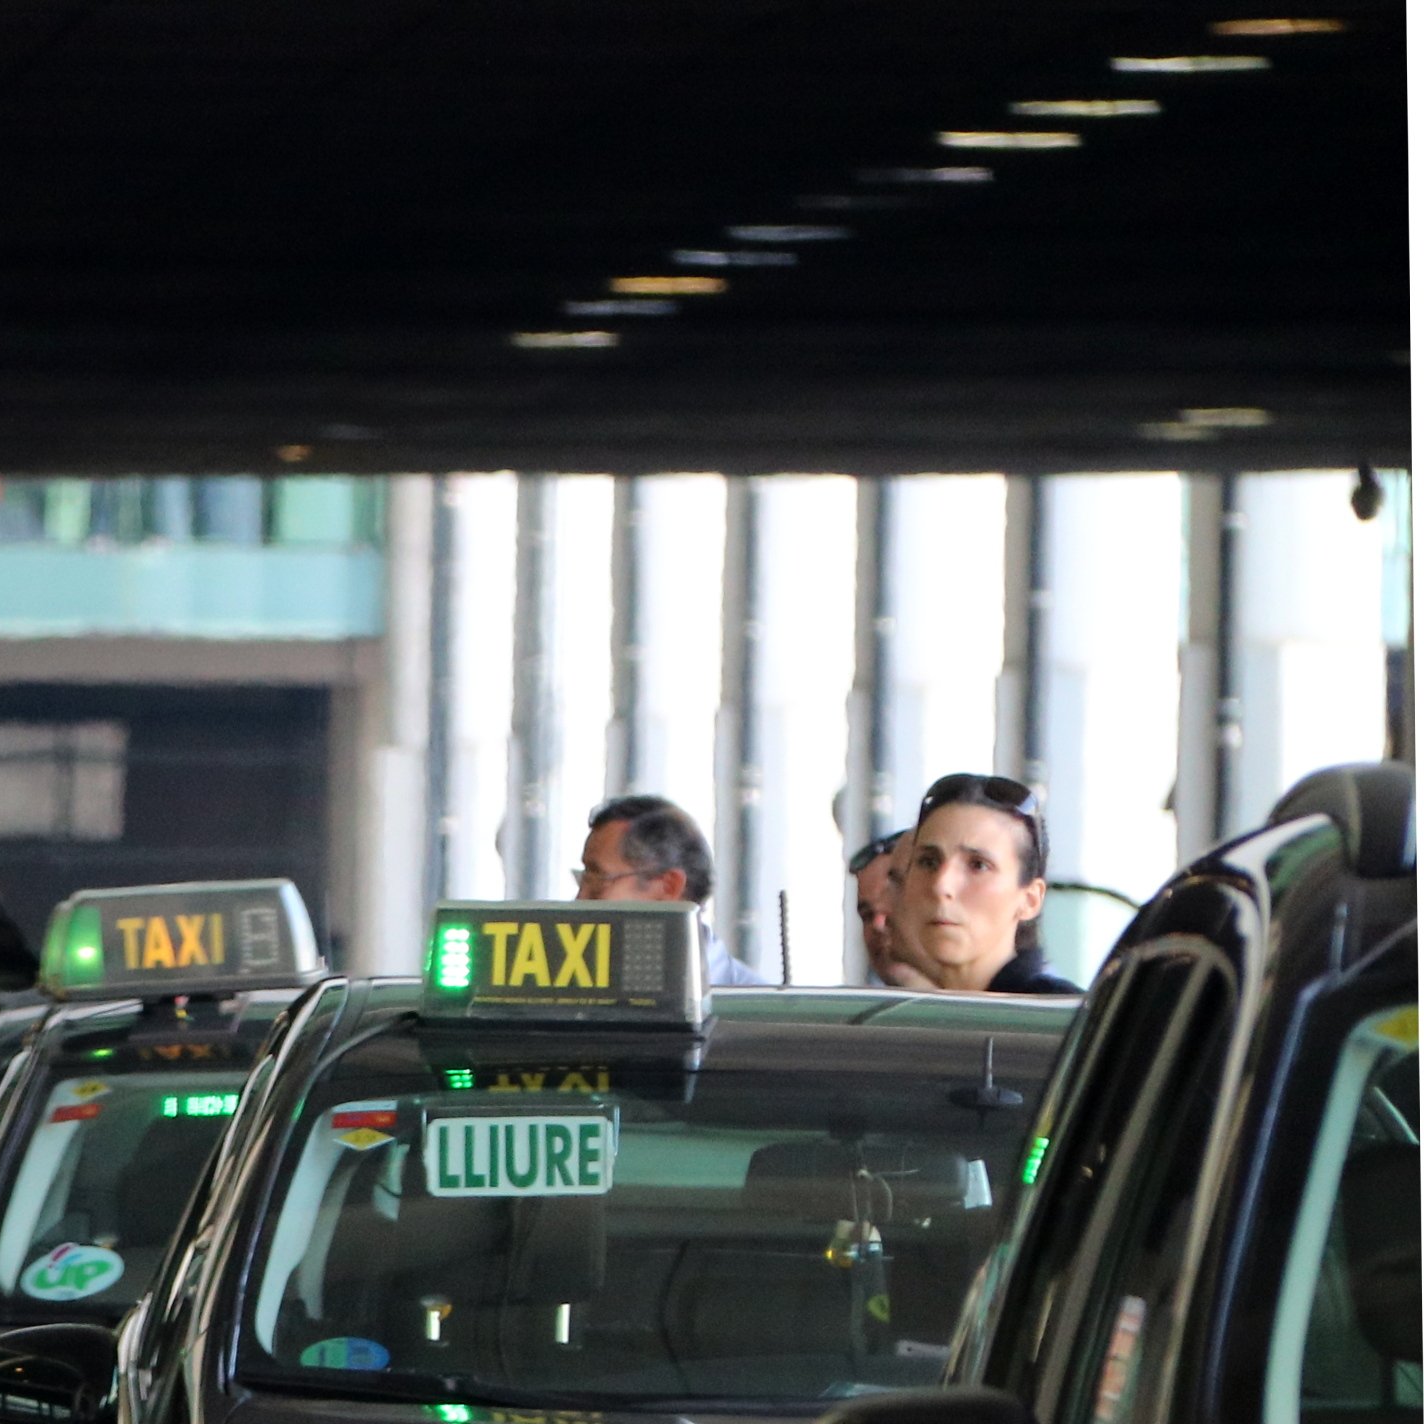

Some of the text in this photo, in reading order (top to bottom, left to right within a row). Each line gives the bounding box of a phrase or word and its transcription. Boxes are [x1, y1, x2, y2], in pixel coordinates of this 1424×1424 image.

[115, 912, 226, 970] TAXI
[481, 921, 612, 988] TAXI
[438, 1123, 601, 1189] LLIURE
